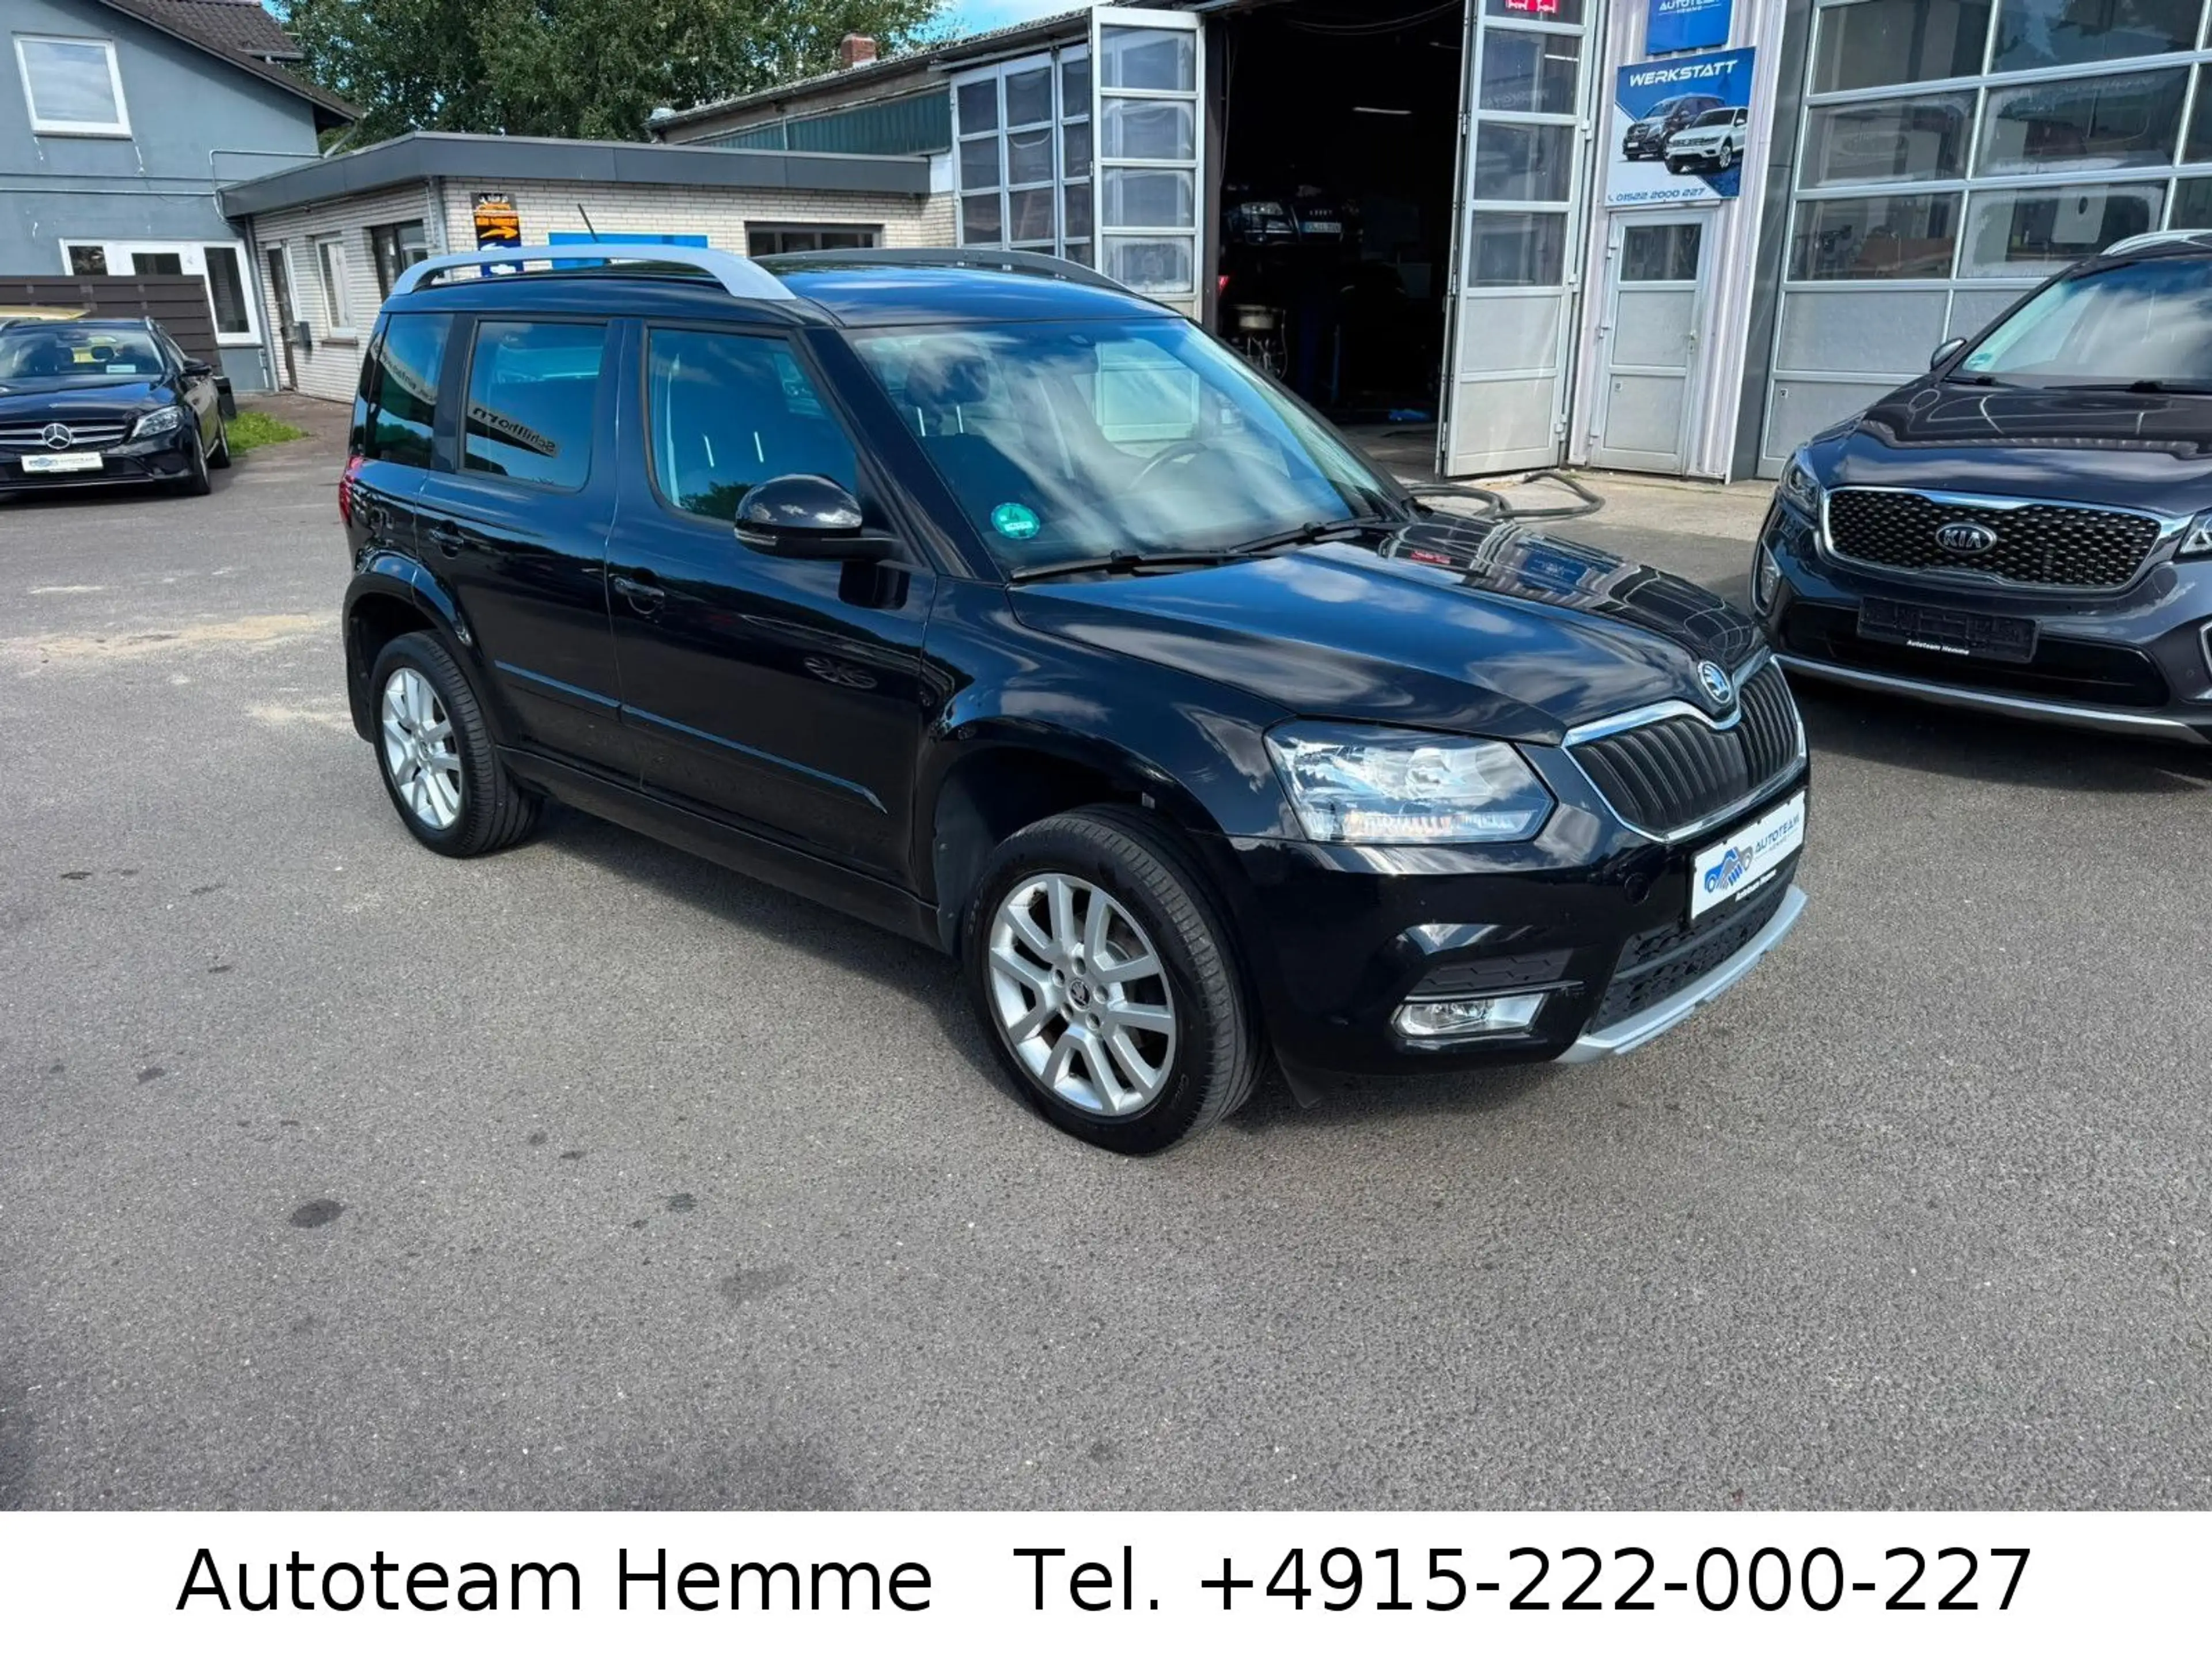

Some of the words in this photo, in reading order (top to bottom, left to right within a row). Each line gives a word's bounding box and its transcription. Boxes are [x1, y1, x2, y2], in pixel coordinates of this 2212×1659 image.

[1630, 59, 1738, 87] WERKSTATT
[1616, 191, 1647, 202] 01522
[1650, 189, 1680, 199] 2000
[1682, 187, 1706, 198] 227
[1944, 529, 1982, 548] KIA
[1756, 812, 1800, 853] AUTOTEAM
